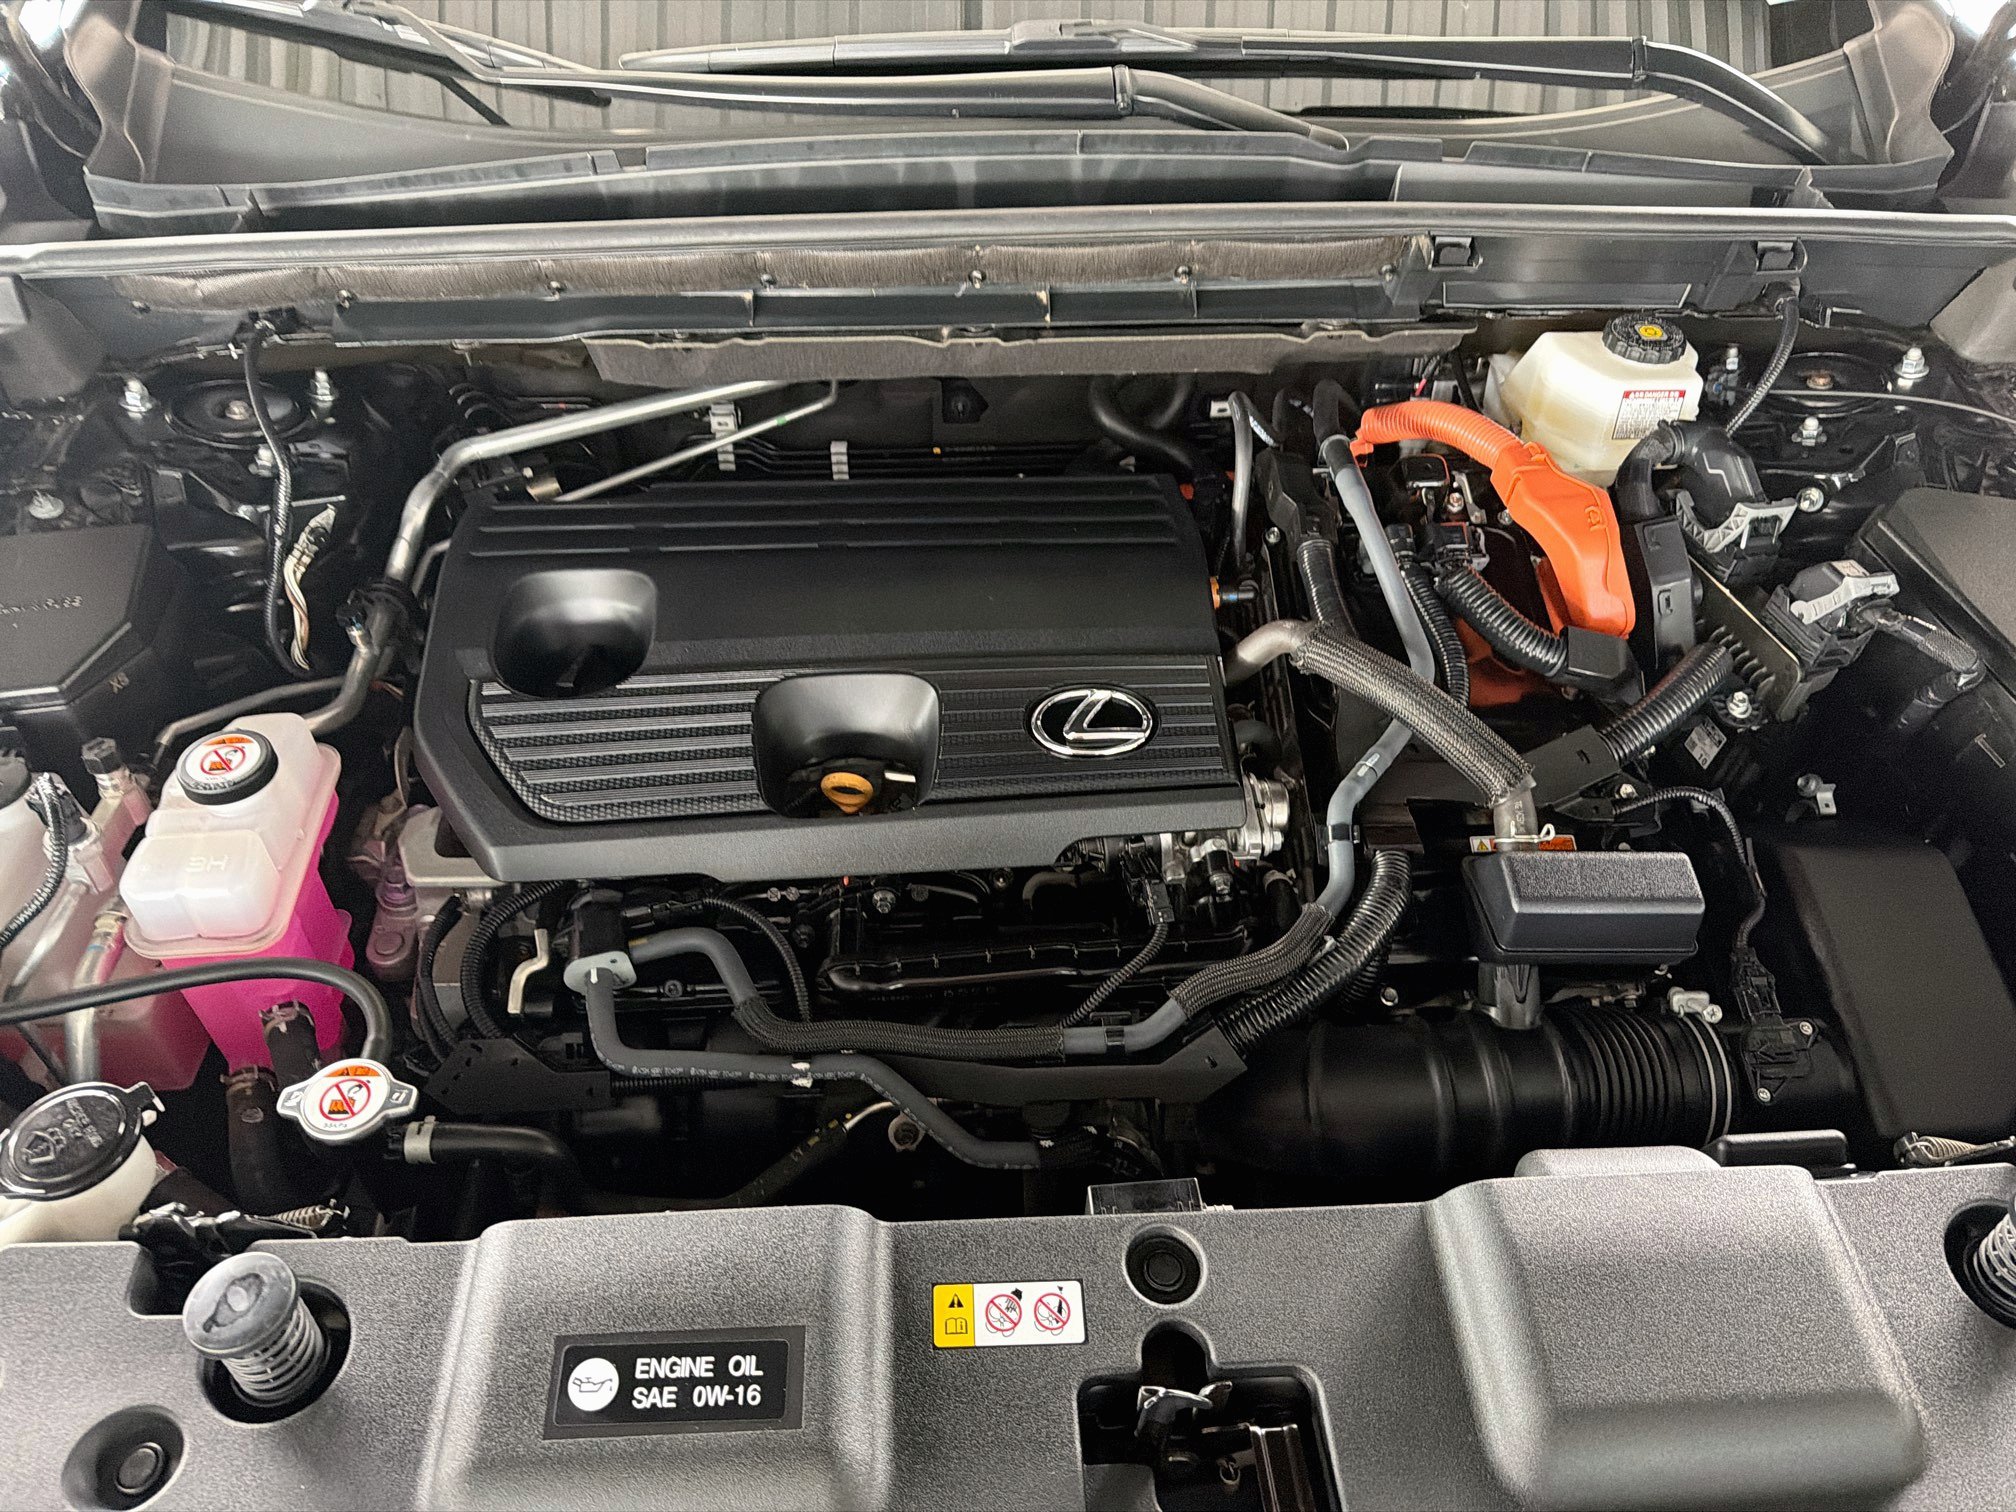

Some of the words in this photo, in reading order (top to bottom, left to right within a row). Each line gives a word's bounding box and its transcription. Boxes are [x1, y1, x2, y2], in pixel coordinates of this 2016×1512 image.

[634, 1355, 715, 1380] ENGINE
[728, 1354, 764, 1378] OIL
[631, 1386, 678, 1410] SAE
[692, 1384, 762, 1408] 0W-16
